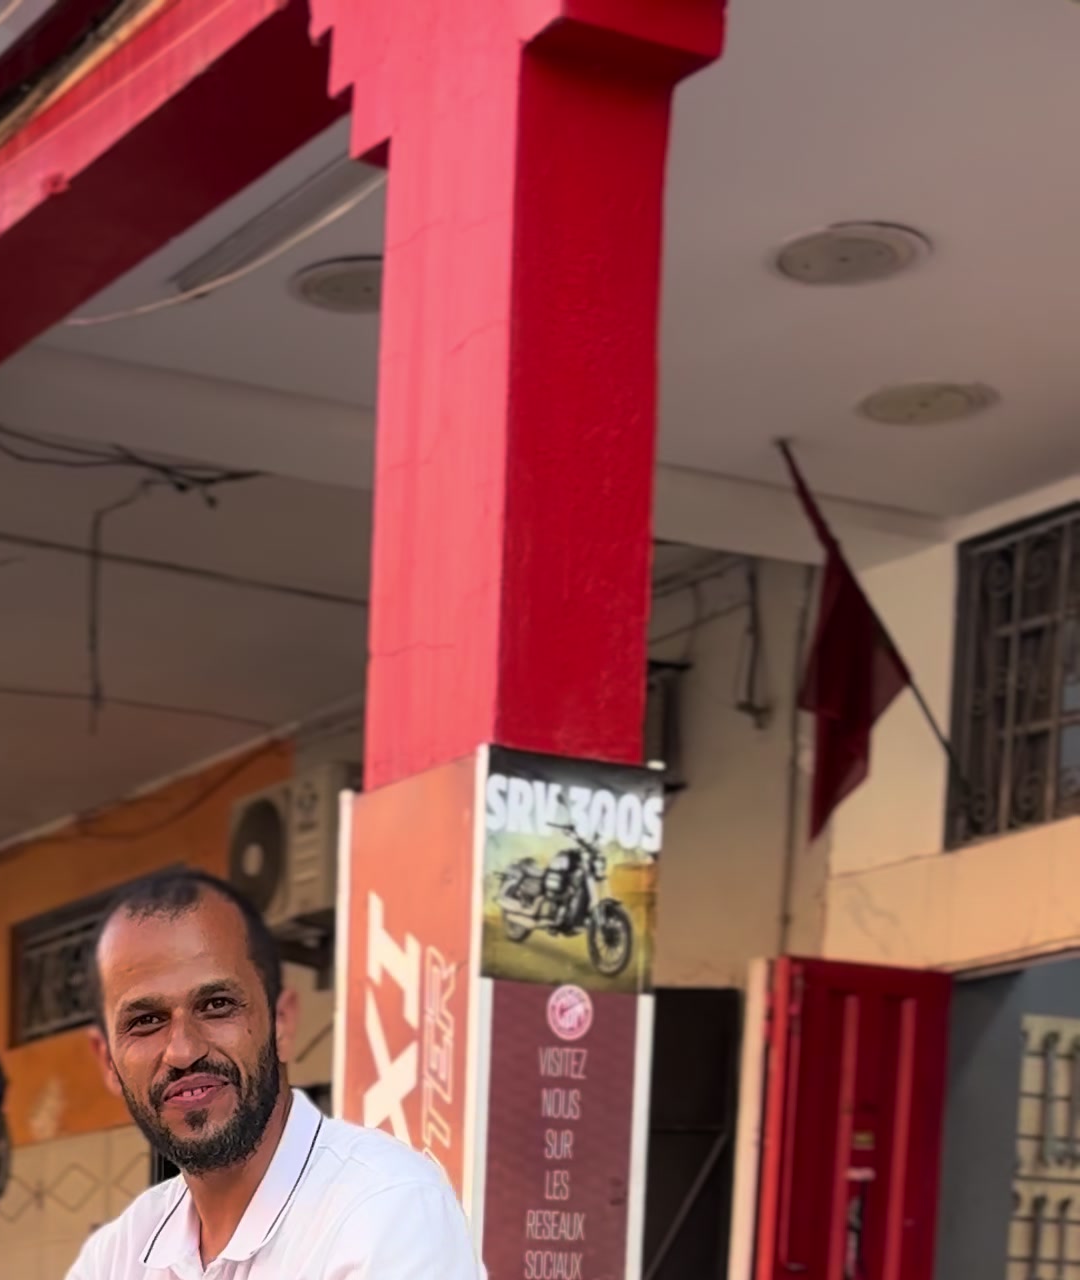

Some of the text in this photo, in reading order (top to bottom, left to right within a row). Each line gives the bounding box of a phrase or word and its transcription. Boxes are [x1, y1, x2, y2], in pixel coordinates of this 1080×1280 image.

[486, 773, 664, 853] SRV 300S
[538, 1047, 588, 1079] VISITEZ
[541, 1088, 581, 1120] NOUS
[544, 1128, 573, 1160] SUR
[544, 1169, 570, 1200] LES
[526, 1209, 586, 1241] RESEAUX
[524, 1250, 584, 1280] SOCIAUX
